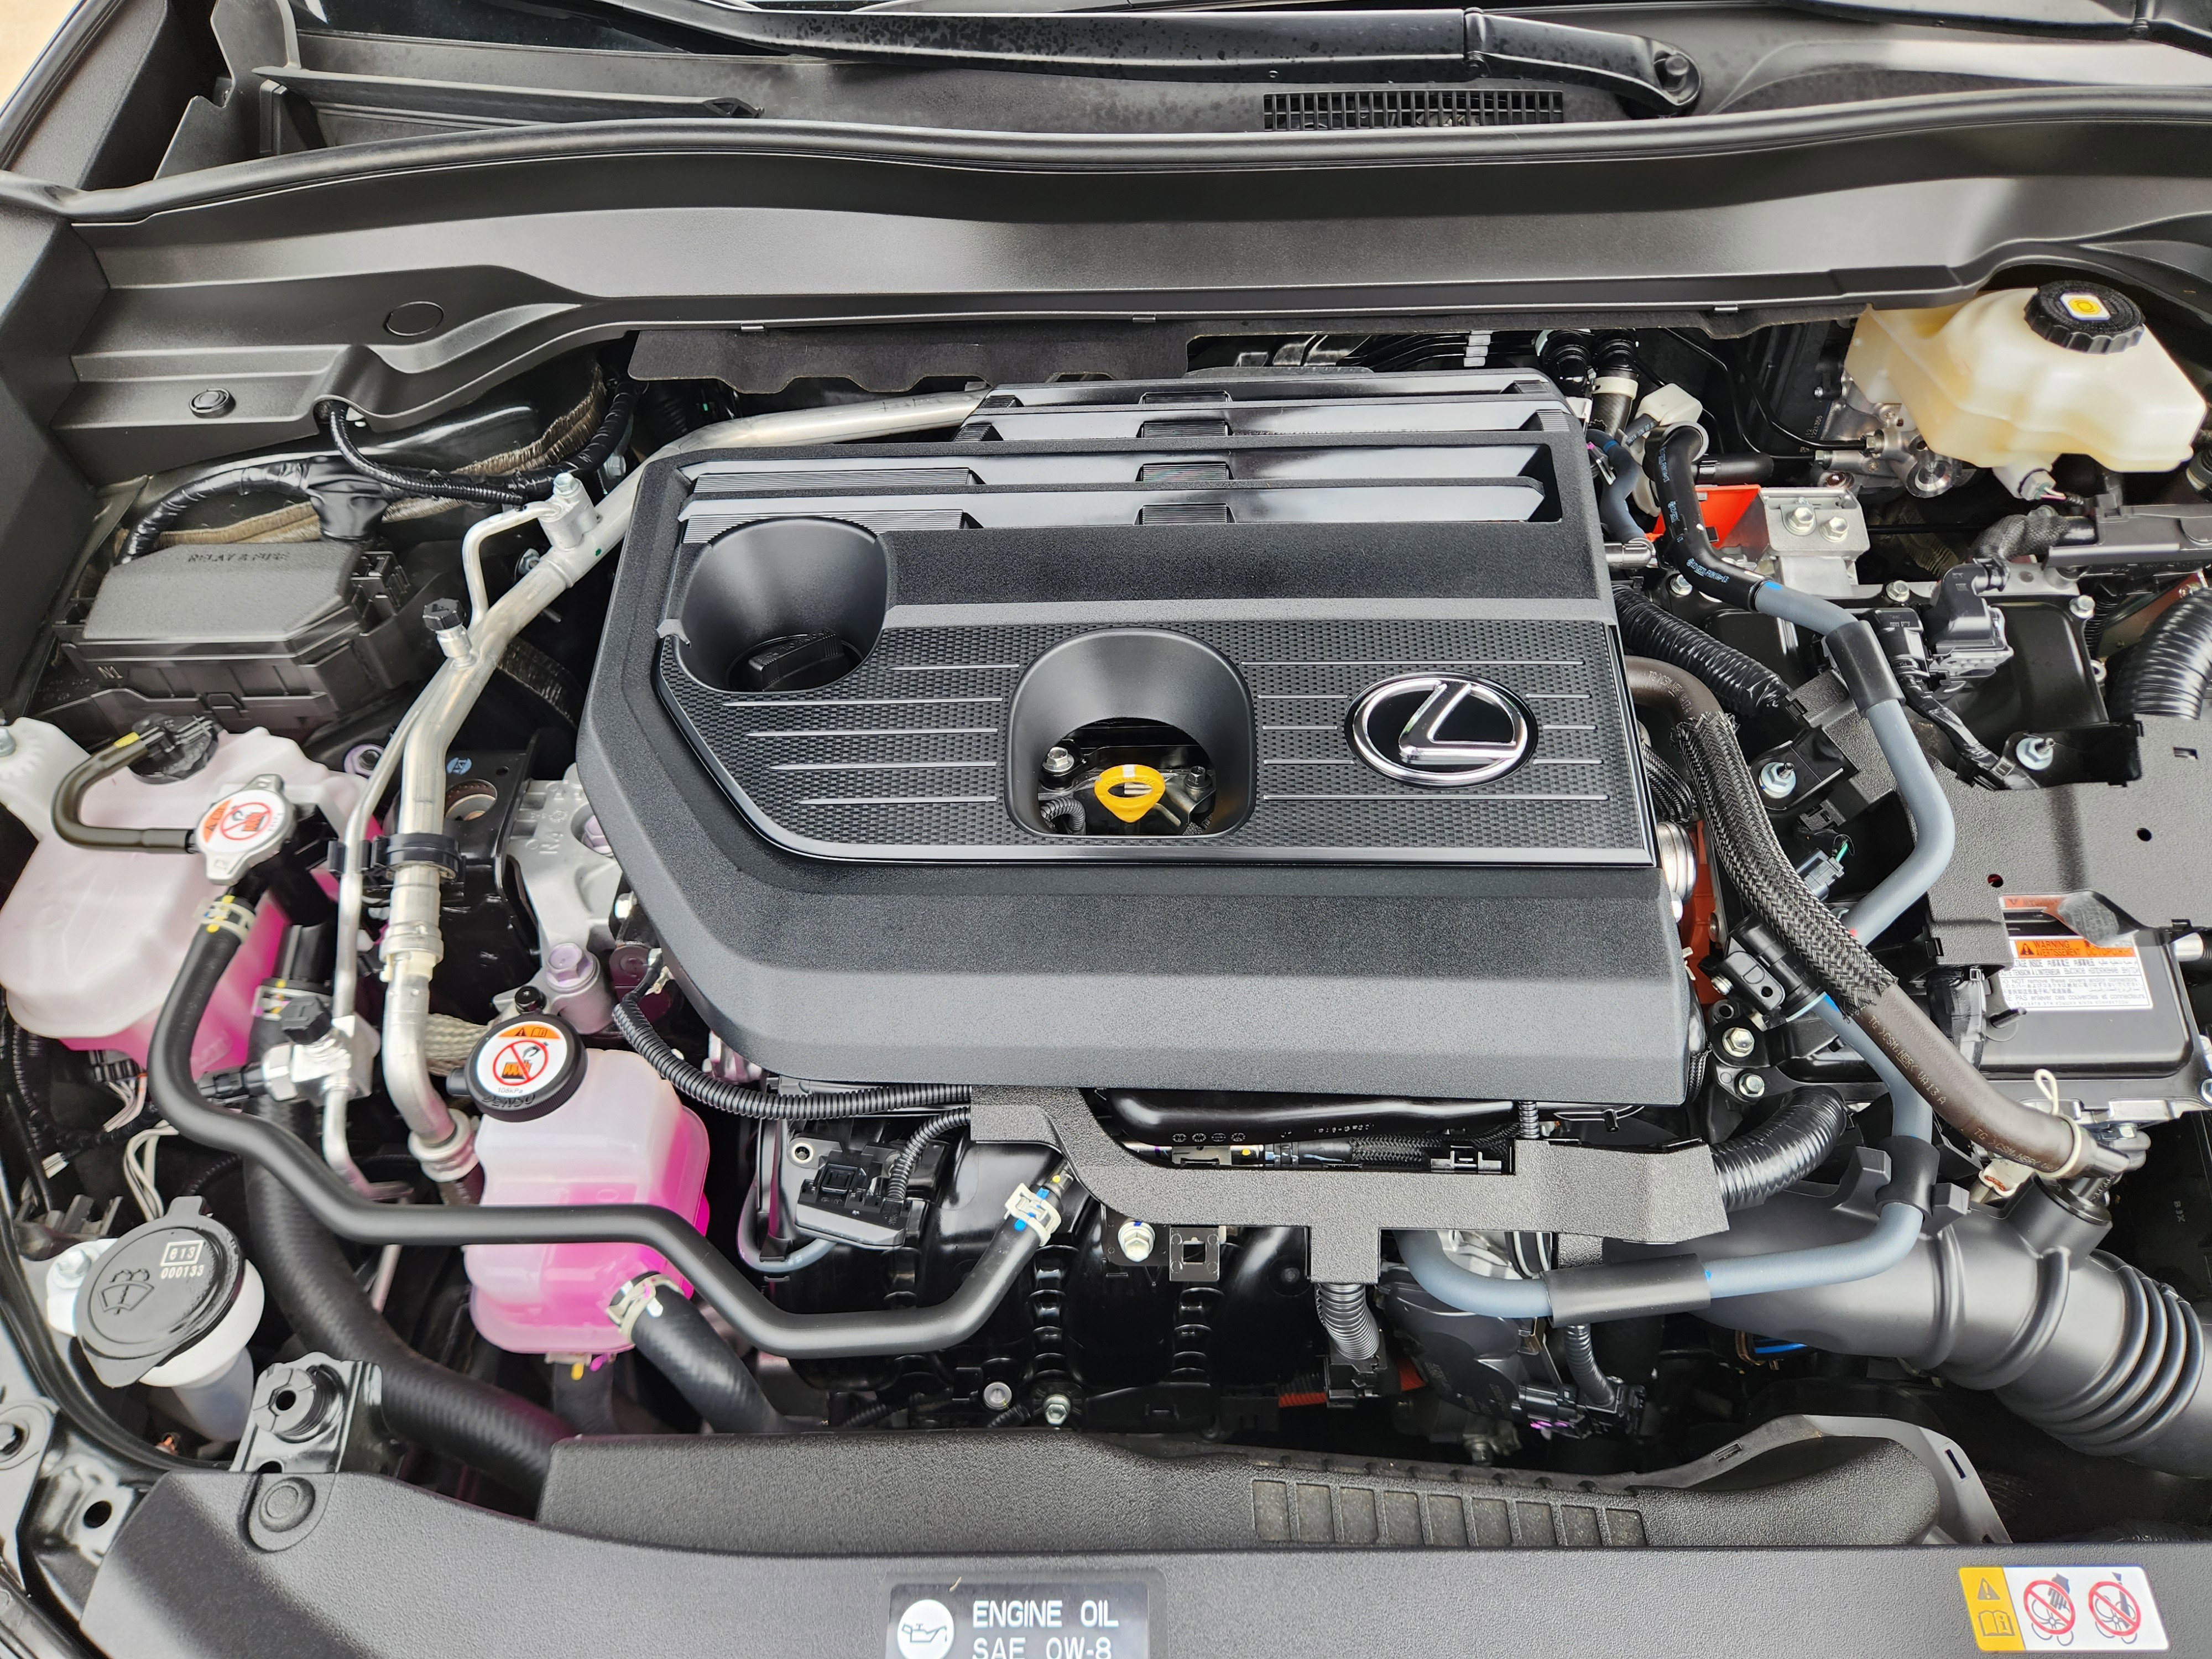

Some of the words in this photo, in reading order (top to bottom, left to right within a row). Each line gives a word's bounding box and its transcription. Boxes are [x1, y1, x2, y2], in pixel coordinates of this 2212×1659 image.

[1869, 1015, 1880, 1029] TG
[482, 1093, 536, 1108] DENSO
[1974, 1128, 1989, 1140] TG
[160, 1264, 205, 1279] 000133
[972, 1599, 1063, 1628] ENGINE
[1080, 1599, 1119, 1628] OIL
[972, 1636, 1026, 1659] SAE
